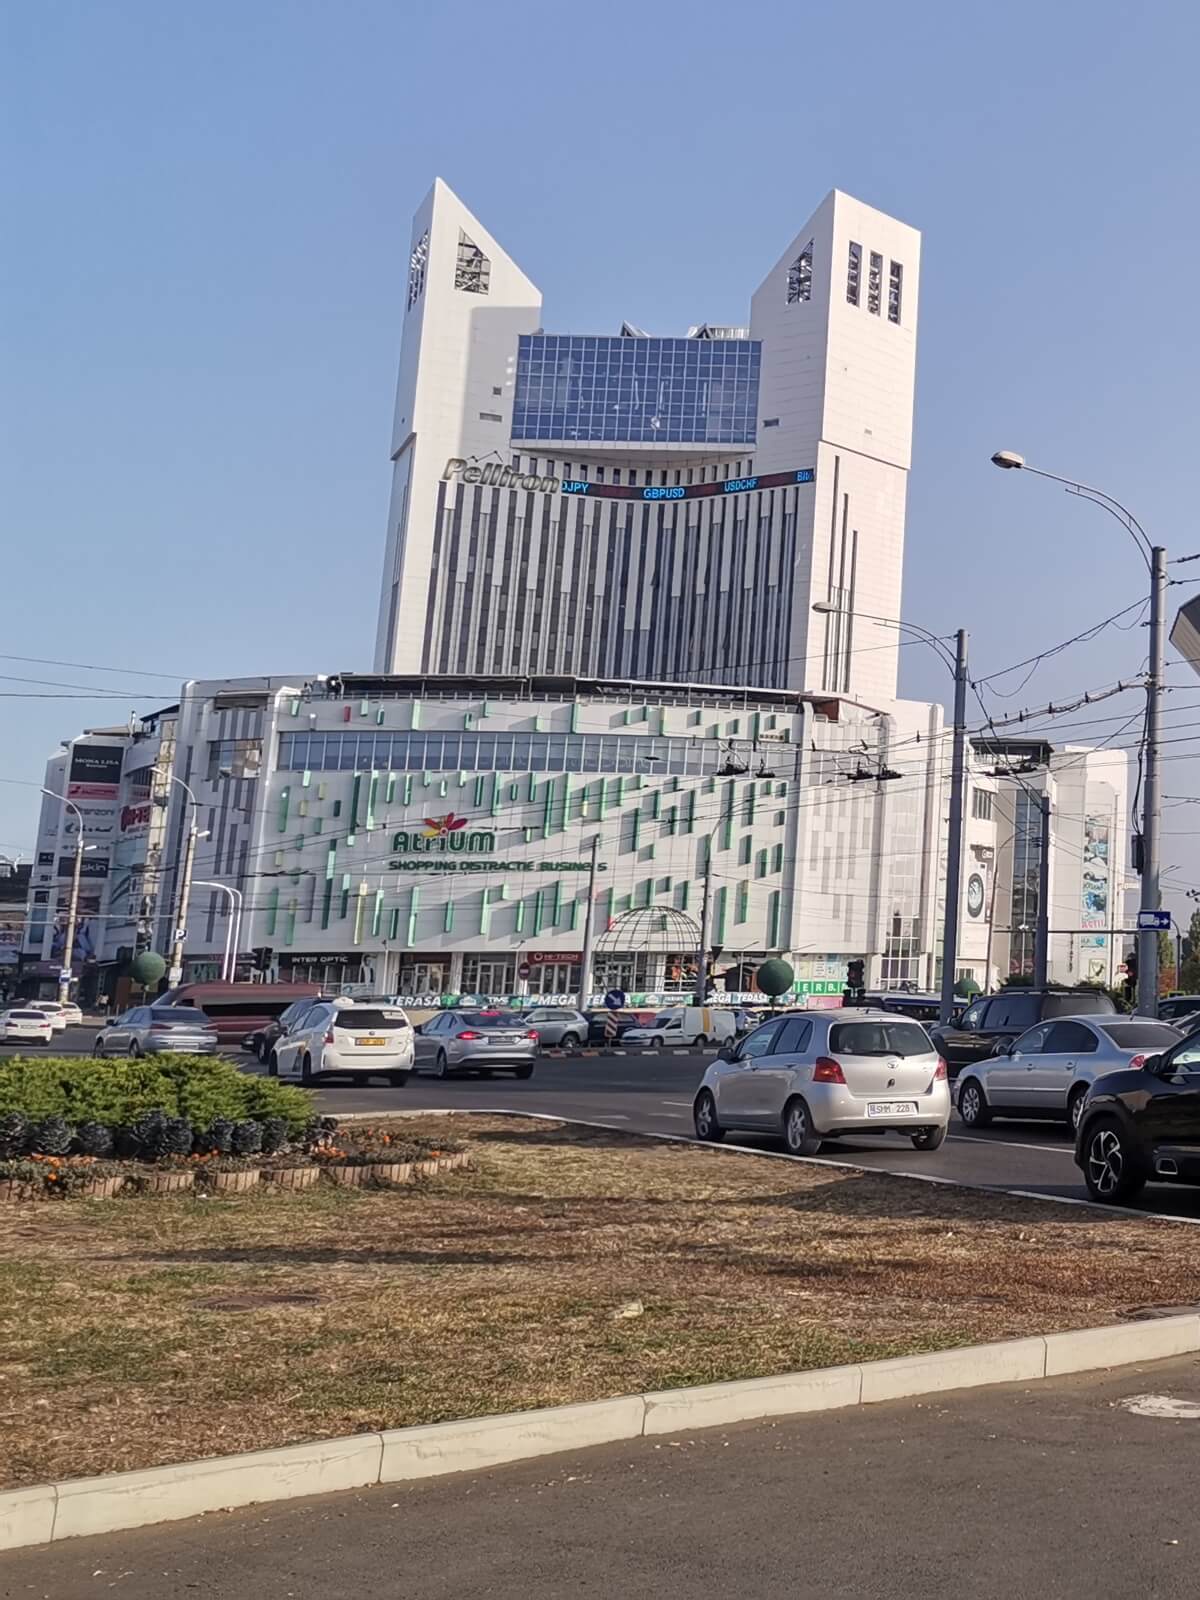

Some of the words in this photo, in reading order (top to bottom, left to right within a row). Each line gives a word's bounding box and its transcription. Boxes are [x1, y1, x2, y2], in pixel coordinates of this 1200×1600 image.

[442, 458, 560, 494] Pelliron
[643, 487, 685, 499] GBPUSD
[724, 478, 758, 492] USDCHF
[388, 860, 457, 871] SHOPPING
[388, 996, 441, 1007] TERASA
[537, 995, 577, 1006] MEGA
